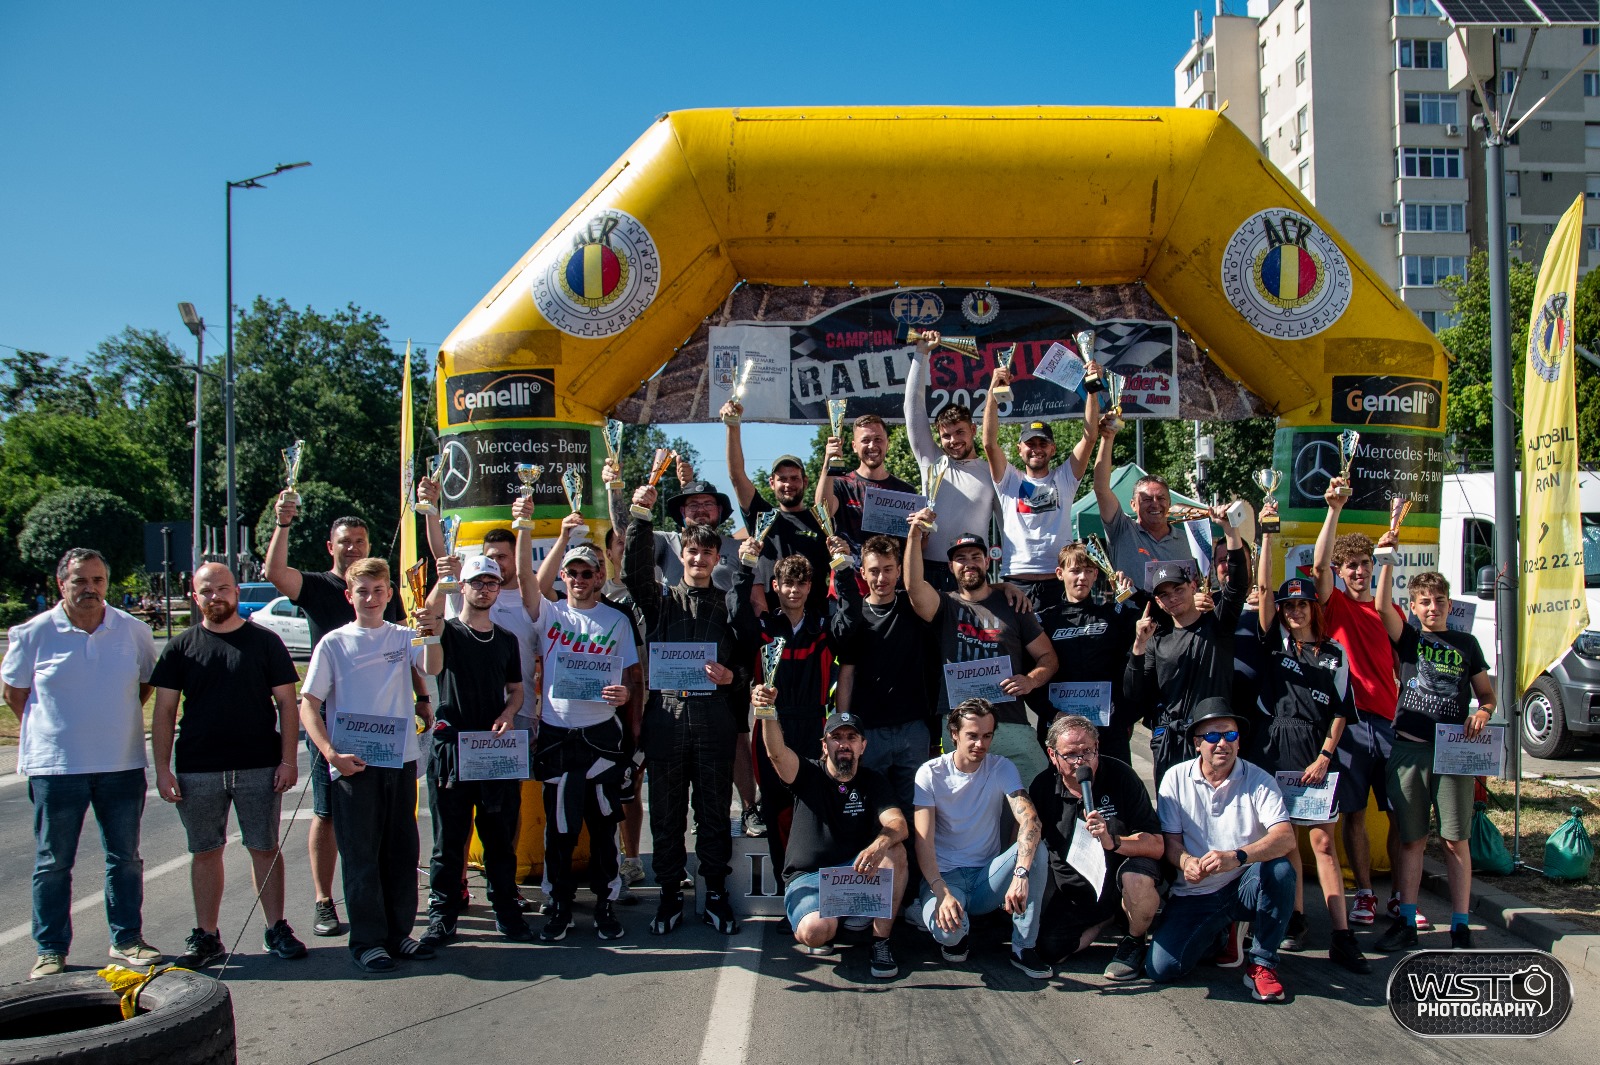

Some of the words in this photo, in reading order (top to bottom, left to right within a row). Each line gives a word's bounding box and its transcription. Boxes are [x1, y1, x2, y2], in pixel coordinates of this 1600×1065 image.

[1263, 216, 1312, 252] ACR
[1230, 227, 1260, 322] AUTOMOBIL
[1275, 301, 1340, 332] CLUBUL
[1045, 348, 1067, 374] DIPLOMA
[797, 350, 917, 399] RALL
[476, 439, 588, 455] Mercedes-Benz
[479, 462, 511, 475] Truck
[548, 462, 564, 474] 75
[1356, 467, 1391, 481] Truck
[1393, 469, 1419, 481] Zone
[1420, 471, 1430, 482] 75
[535, 483, 563, 495] Mare
[1410, 490, 1430, 502] Mare
[874, 496, 916, 512] DIPLOMA
[1551, 552, 1569, 569] 22
[660, 650, 706, 660] DIPLOMA
[565, 659, 612, 673] DIPLOMA
[956, 664, 1002, 680] DIPLOMA
[1058, 688, 1101, 699] DIPLOMA
[345, 720, 396, 735] DIPLOMA
[470, 738, 518, 750] DIPLOMA
[831, 874, 881, 886] DIPLOMA
